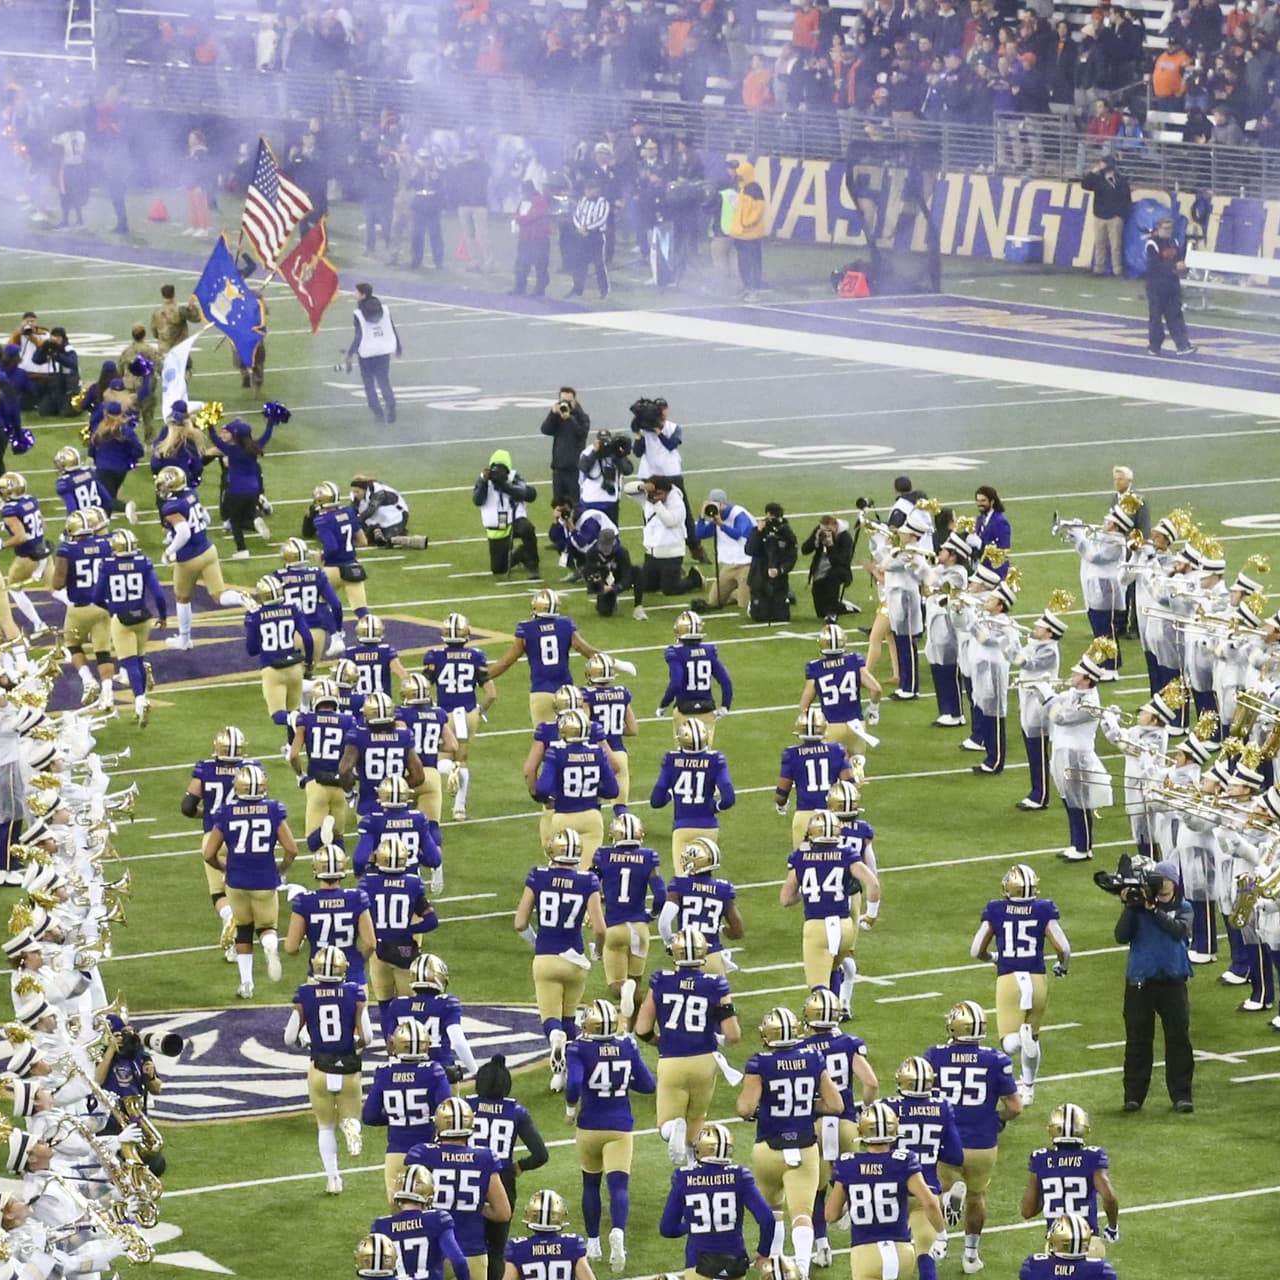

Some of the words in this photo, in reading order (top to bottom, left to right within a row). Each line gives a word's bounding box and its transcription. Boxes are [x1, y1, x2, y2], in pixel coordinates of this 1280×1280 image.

[341, 524, 353, 552] 7
[110, 573, 143, 602] 89
[260, 620, 295, 651] 80
[540, 635, 559, 665] 8
[357, 664, 383, 693] 81
[438, 663, 474, 693] 42
[686, 660, 711, 691] 19
[819, 671, 857, 705] 54
[311, 727, 343, 760] 12
[414, 723, 440, 754] 18
[365, 748, 404, 779] 66
[805, 758, 830, 791] 11
[563, 765, 601, 798] 82
[673, 771, 706, 804] 41
[229, 819, 271, 853] 72
[552, 877, 574, 889] OTTON
[618, 868, 631, 903] 1
[799, 866, 846, 903] 44
[375, 894, 410, 929] 10
[539, 891, 584, 929] 87
[682, 896, 723, 934] 23
[310, 912, 353, 948] 75
[1002, 920, 1039, 958] 15
[319, 1004, 342, 1042] 8
[663, 993, 708, 1032] 78
[599, 1046, 620, 1057] HENRY
[392, 1072, 415, 1083] GROSS
[588, 1060, 632, 1098] 47
[939, 1066, 988, 1106] 55
[383, 1089, 429, 1127] 95
[769, 1076, 815, 1117] 39
[909, 1106, 941, 1117] JACKSON
[471, 1117, 514, 1159] 28
[898, 1124, 943, 1165] 25
[442, 1152, 474, 1163] PEACOCK
[1058, 1156, 1082, 1168] DAVIS
[432, 1169, 481, 1211] 65
[687, 1173, 736, 1187] McCALLISTER
[685, 1191, 737, 1234] 38
[849, 1182, 900, 1225] 86
[1041, 1177, 1089, 1217] 22
[391, 1218, 424, 1233] PURCELL
[532, 1244, 562, 1256] HOLMES
[1054, 1264, 1075, 1276] CULP
